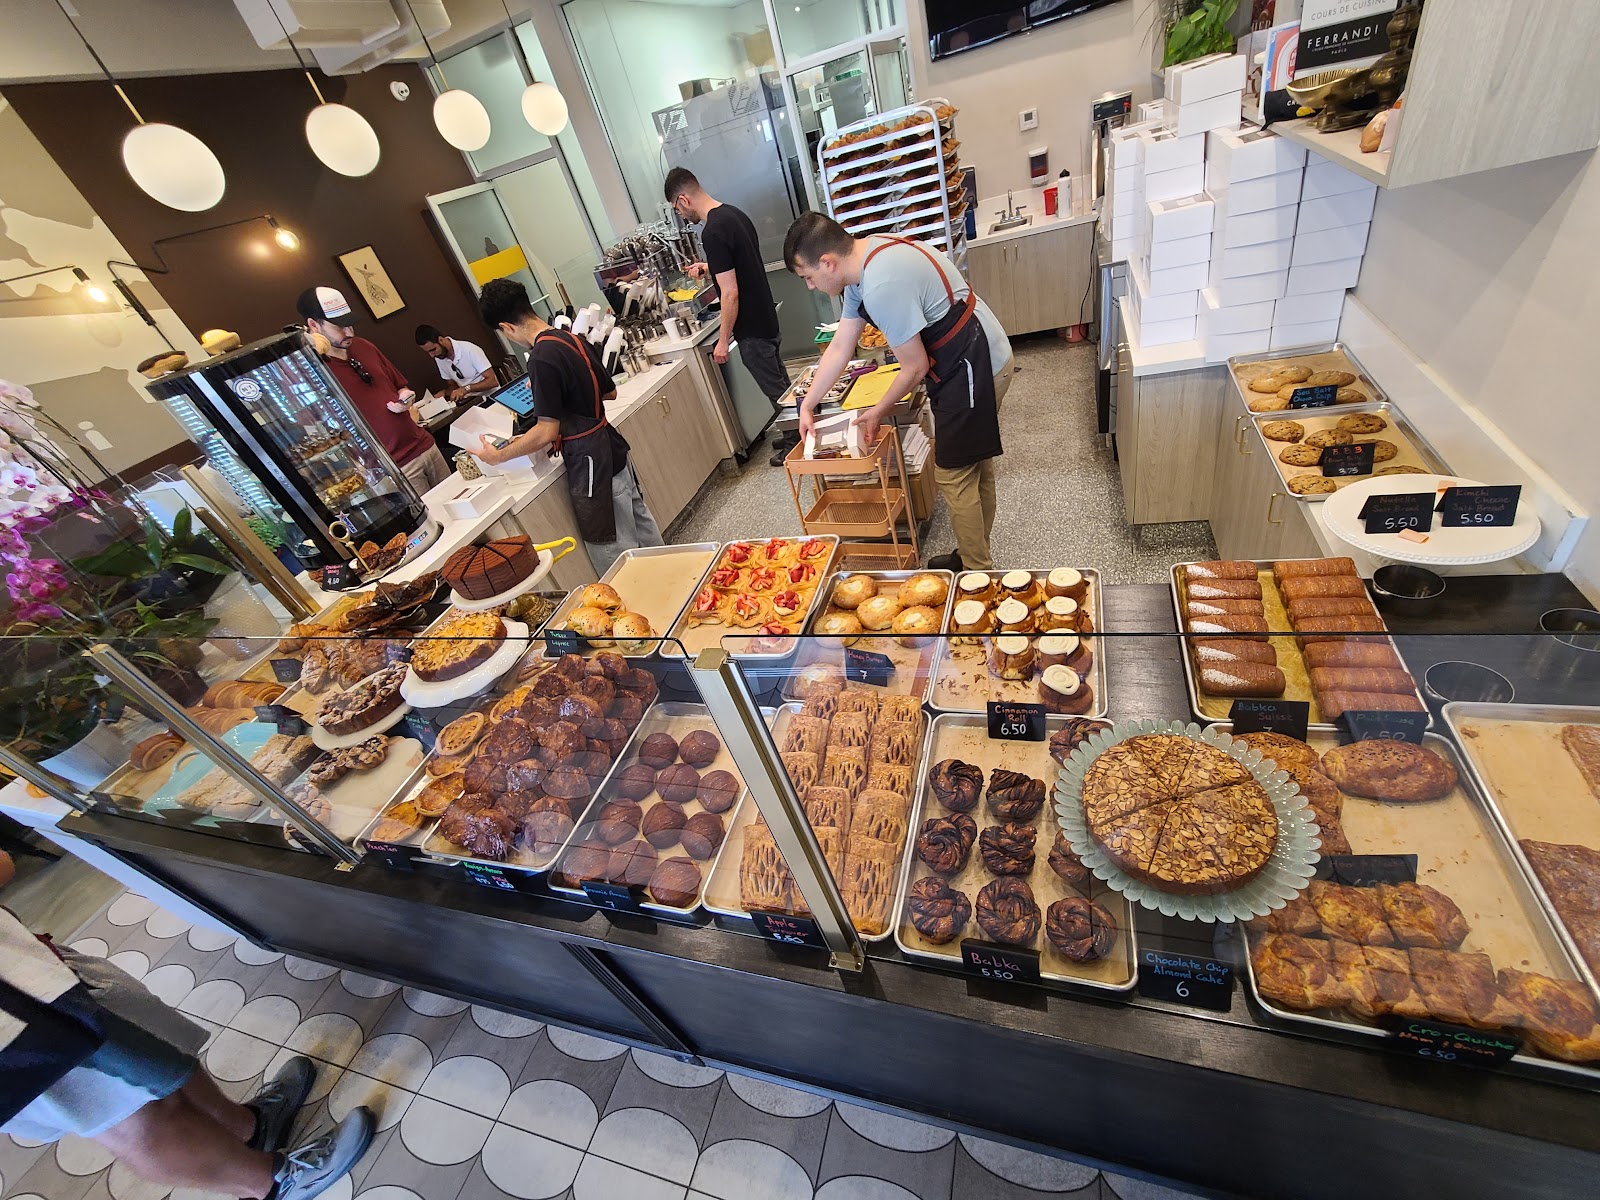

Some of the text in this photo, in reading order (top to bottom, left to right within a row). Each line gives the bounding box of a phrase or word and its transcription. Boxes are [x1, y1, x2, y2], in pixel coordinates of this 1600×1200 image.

[1311, 8, 1337, 20] COURS
[1340, 5, 1350, 13] DE
[1307, 24, 1379, 48] FERRANDI
[1314, 386, 1332, 394] Salt
[1455, 488, 1489, 497] Kimchi
[1384, 516, 1418, 530] 5.50
[1460, 513, 1494, 525] 5.50
[859, 669, 868, 680] 7
[994, 704, 1039, 715] Cinnamon
[1237, 701, 1277, 712] Babka
[1007, 713, 1027, 722] Roll
[1000, 722, 1027, 735] 6.50
[766, 915, 798, 928] Apple
[970, 952, 1022, 972] Babka
[1145, 952, 1229, 976] Chocolate Chip
[981, 967, 1014, 980] 5.50
[1153, 964, 1224, 985] Almond Cake
[1176, 980, 1190, 997] 6
